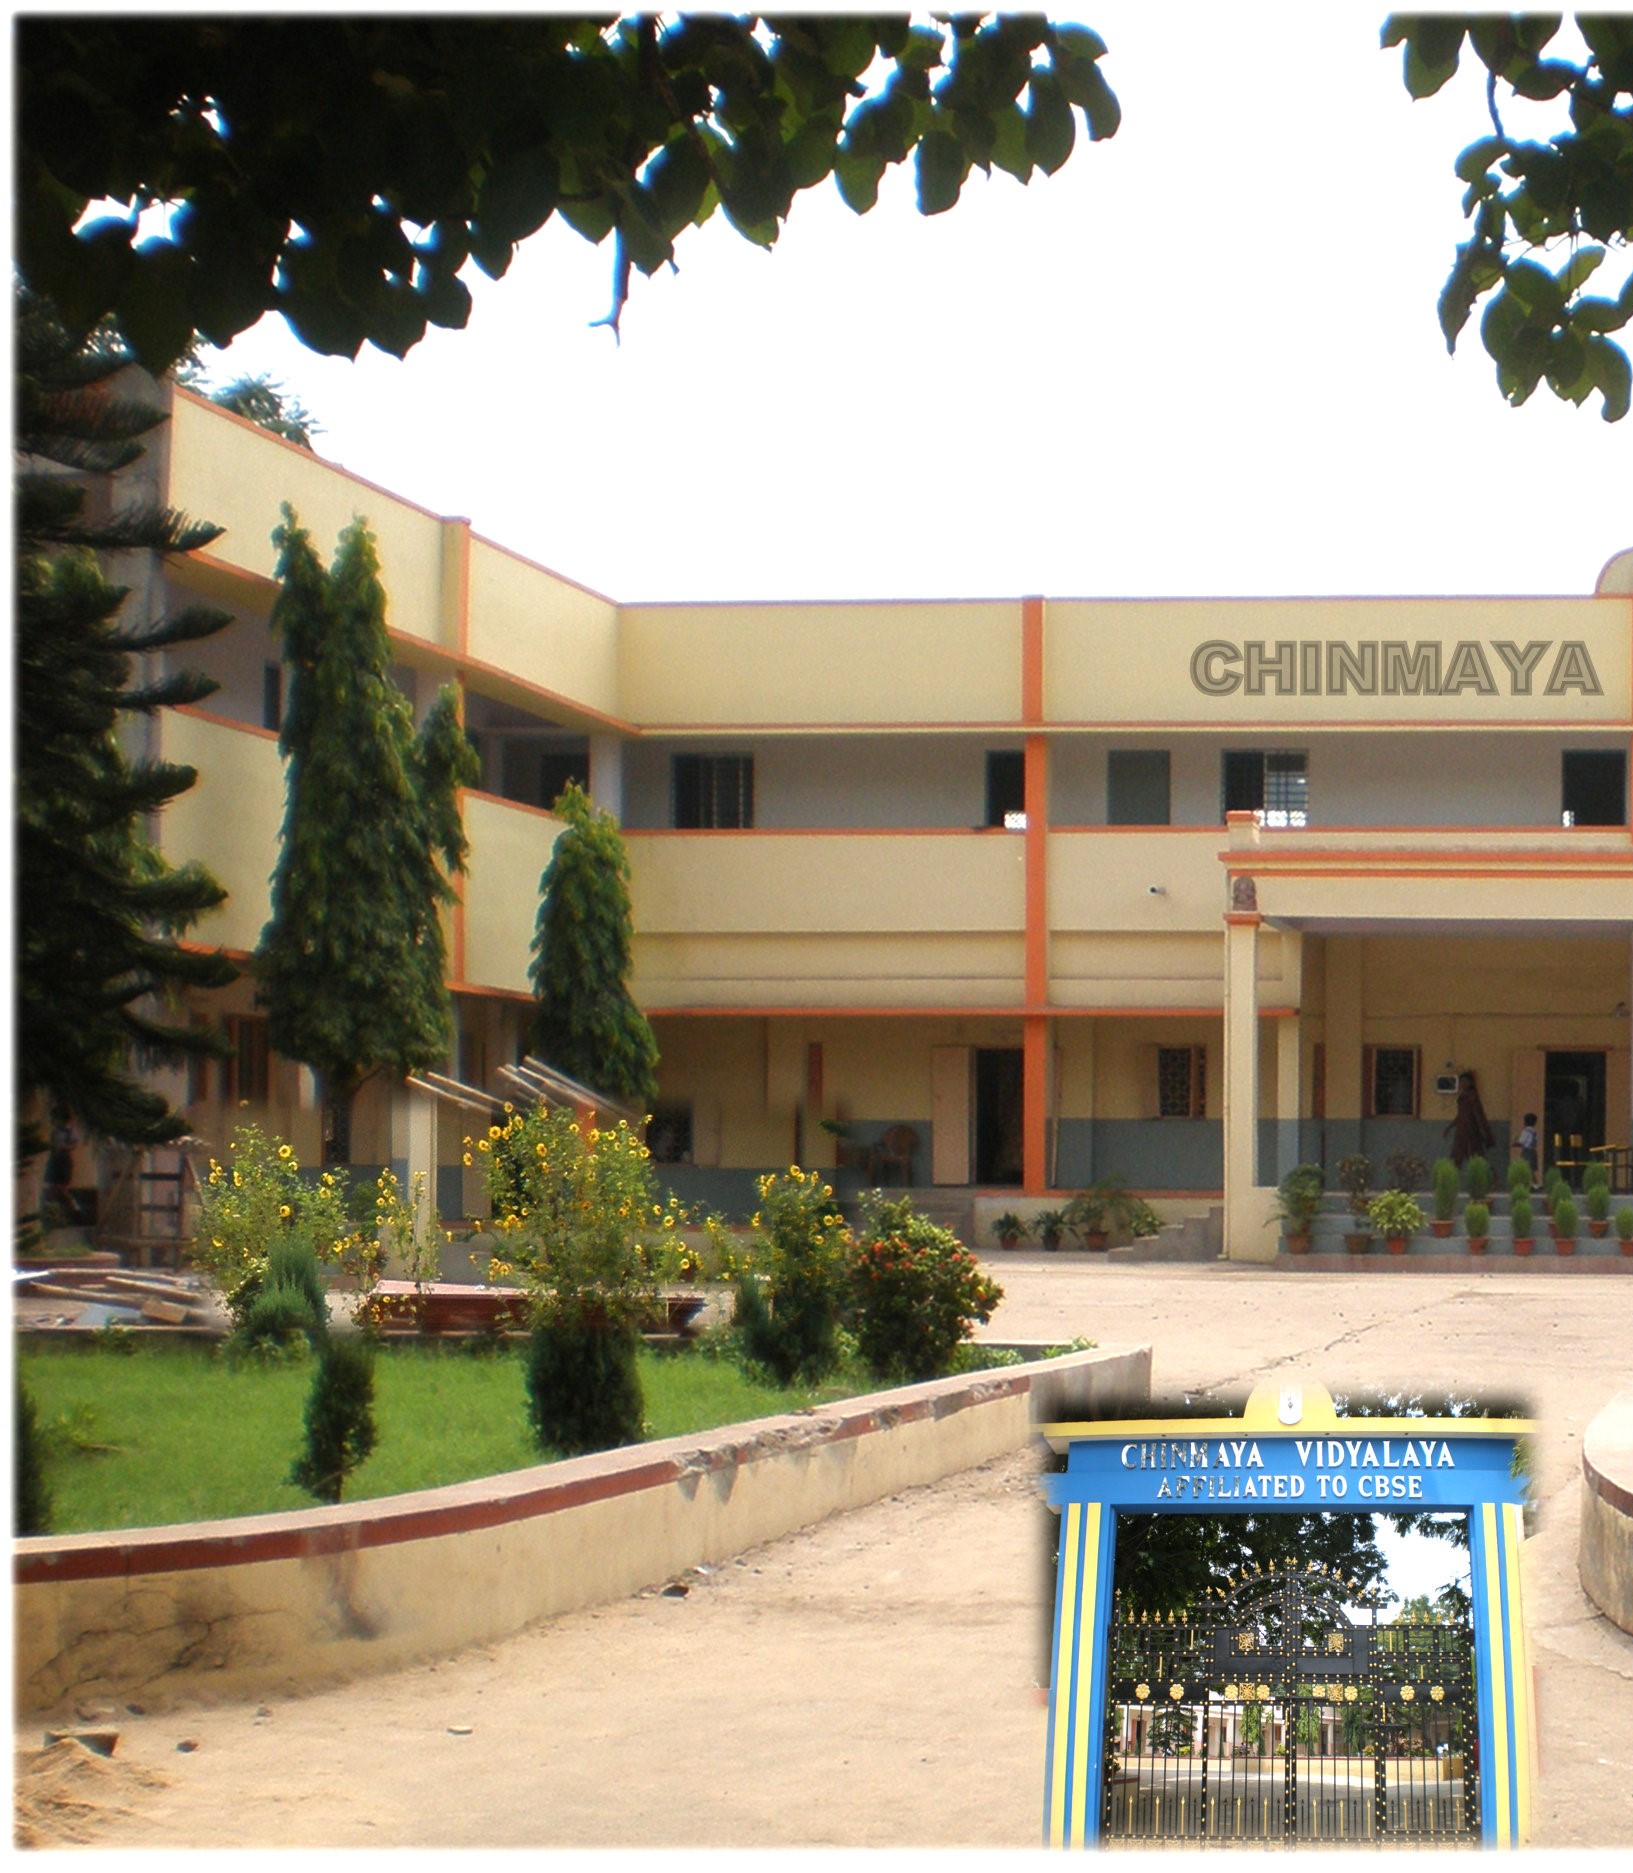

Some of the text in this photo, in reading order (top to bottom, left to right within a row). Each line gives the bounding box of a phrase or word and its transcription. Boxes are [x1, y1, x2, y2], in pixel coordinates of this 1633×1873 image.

[1121, 1440, 1455, 1470] CHINMAYA VIDYALAYA
[1156, 1475, 1423, 1499] AFFILIATED TO CBSE
